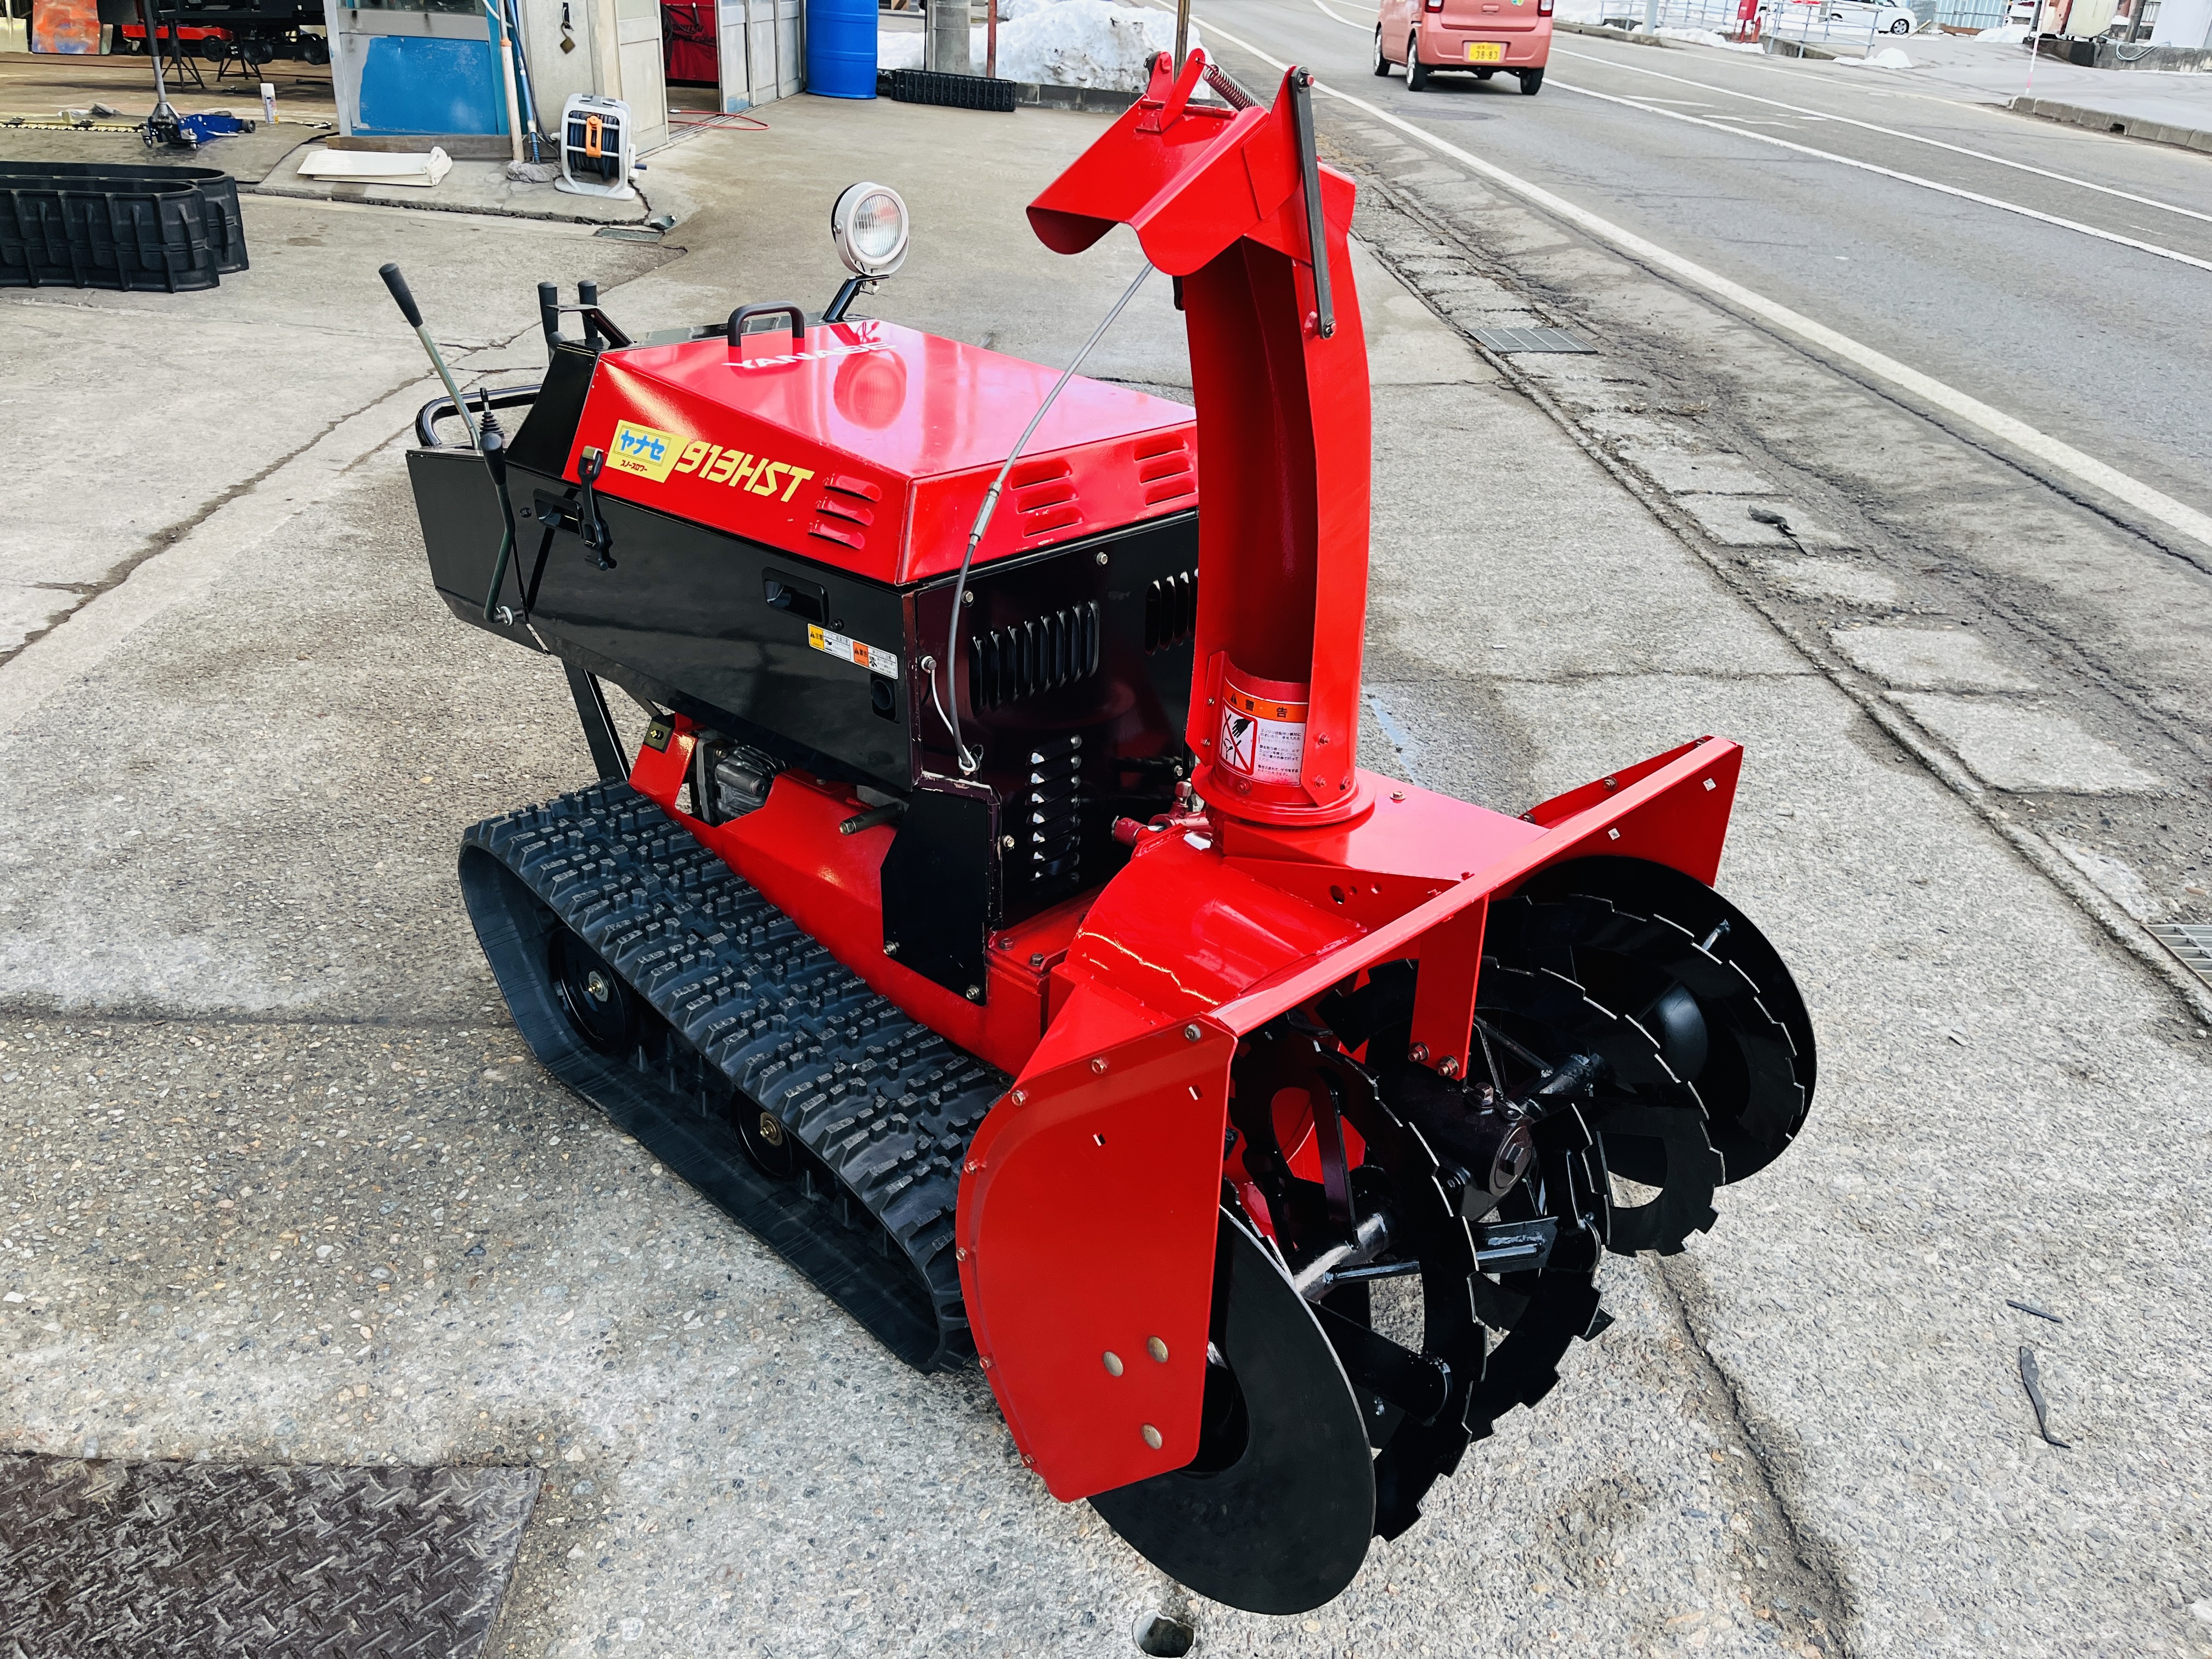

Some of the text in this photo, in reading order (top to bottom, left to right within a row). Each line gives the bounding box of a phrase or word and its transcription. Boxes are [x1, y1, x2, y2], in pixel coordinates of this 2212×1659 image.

[721, 341, 896, 369] YANASE
[620, 430, 665, 461] ヤナセ
[620, 460, 647, 472] スノースロワー
[674, 441, 815, 503] 913HST
